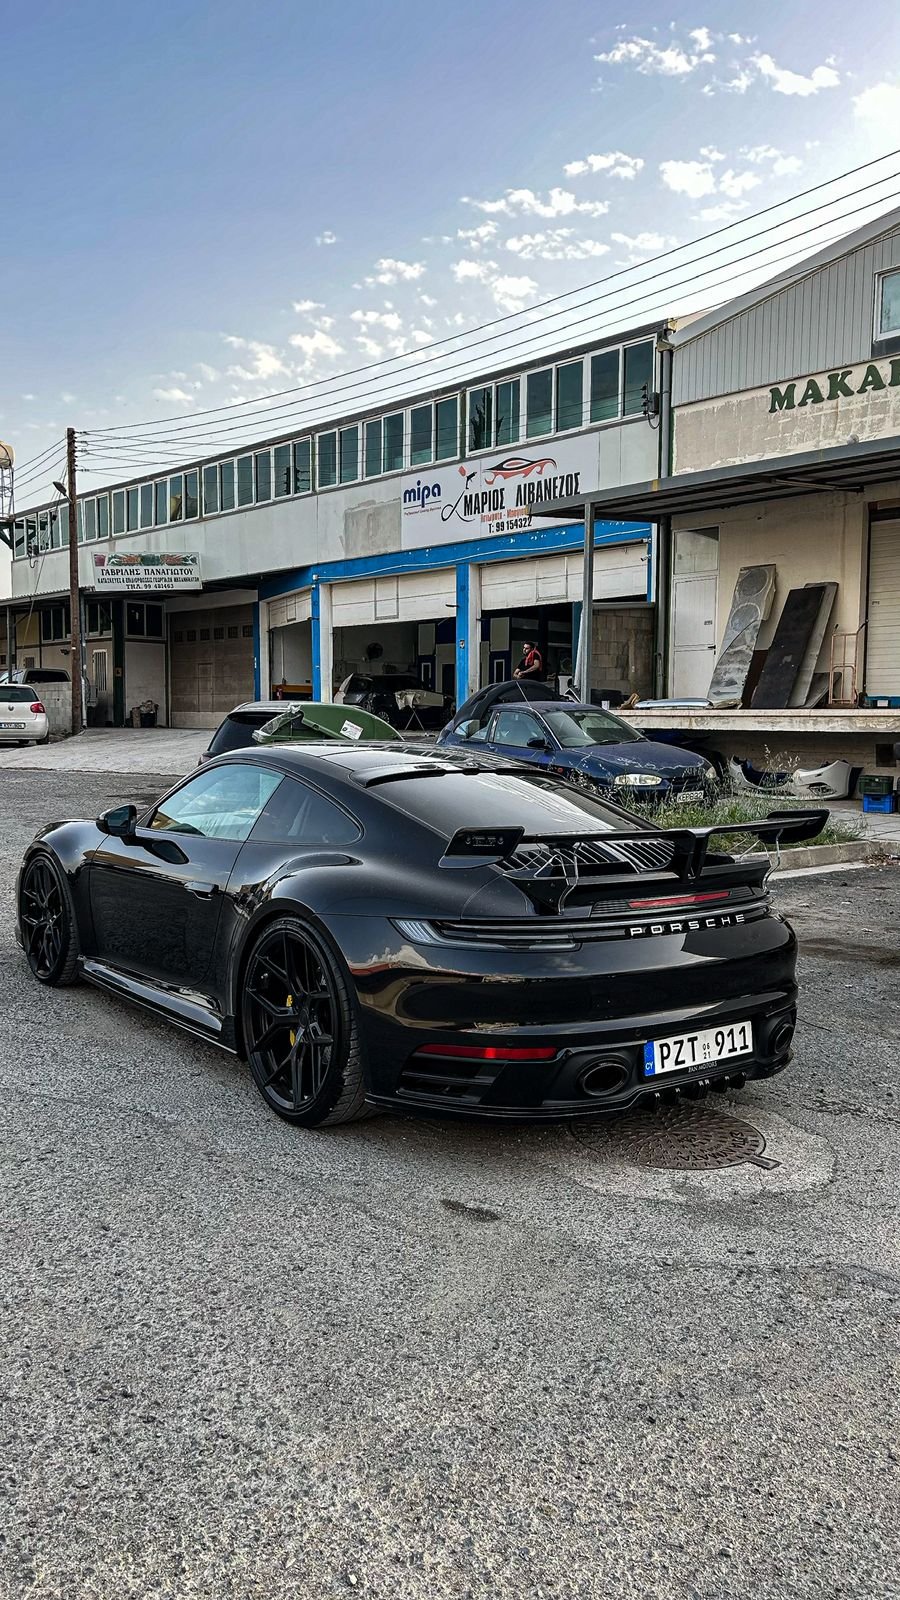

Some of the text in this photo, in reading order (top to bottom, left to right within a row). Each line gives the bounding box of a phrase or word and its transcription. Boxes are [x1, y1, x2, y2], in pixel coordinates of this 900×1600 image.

[403, 479, 442, 508] mipa
[463, 471, 581, 517] ΜΑΡΙΟΣ ΛΙΒΑΝΕΖΟΣ
[495, 521, 505, 532] 99
[506, 516, 532, 531] 154322
[101, 568, 194, 576] ΓΑΒΡΙΛΗΣ ΠΑΝΑΓΙΩΤΟΥ
[630, 913, 745, 937] PORSCHE
[659, 1025, 749, 1069] PZT 911
[702, 1042, 710, 1050] 06
[703, 1051, 711, 1059] 21
[645, 1061, 654, 1070] CY
[698, 1061, 718, 1071] MOTORS
